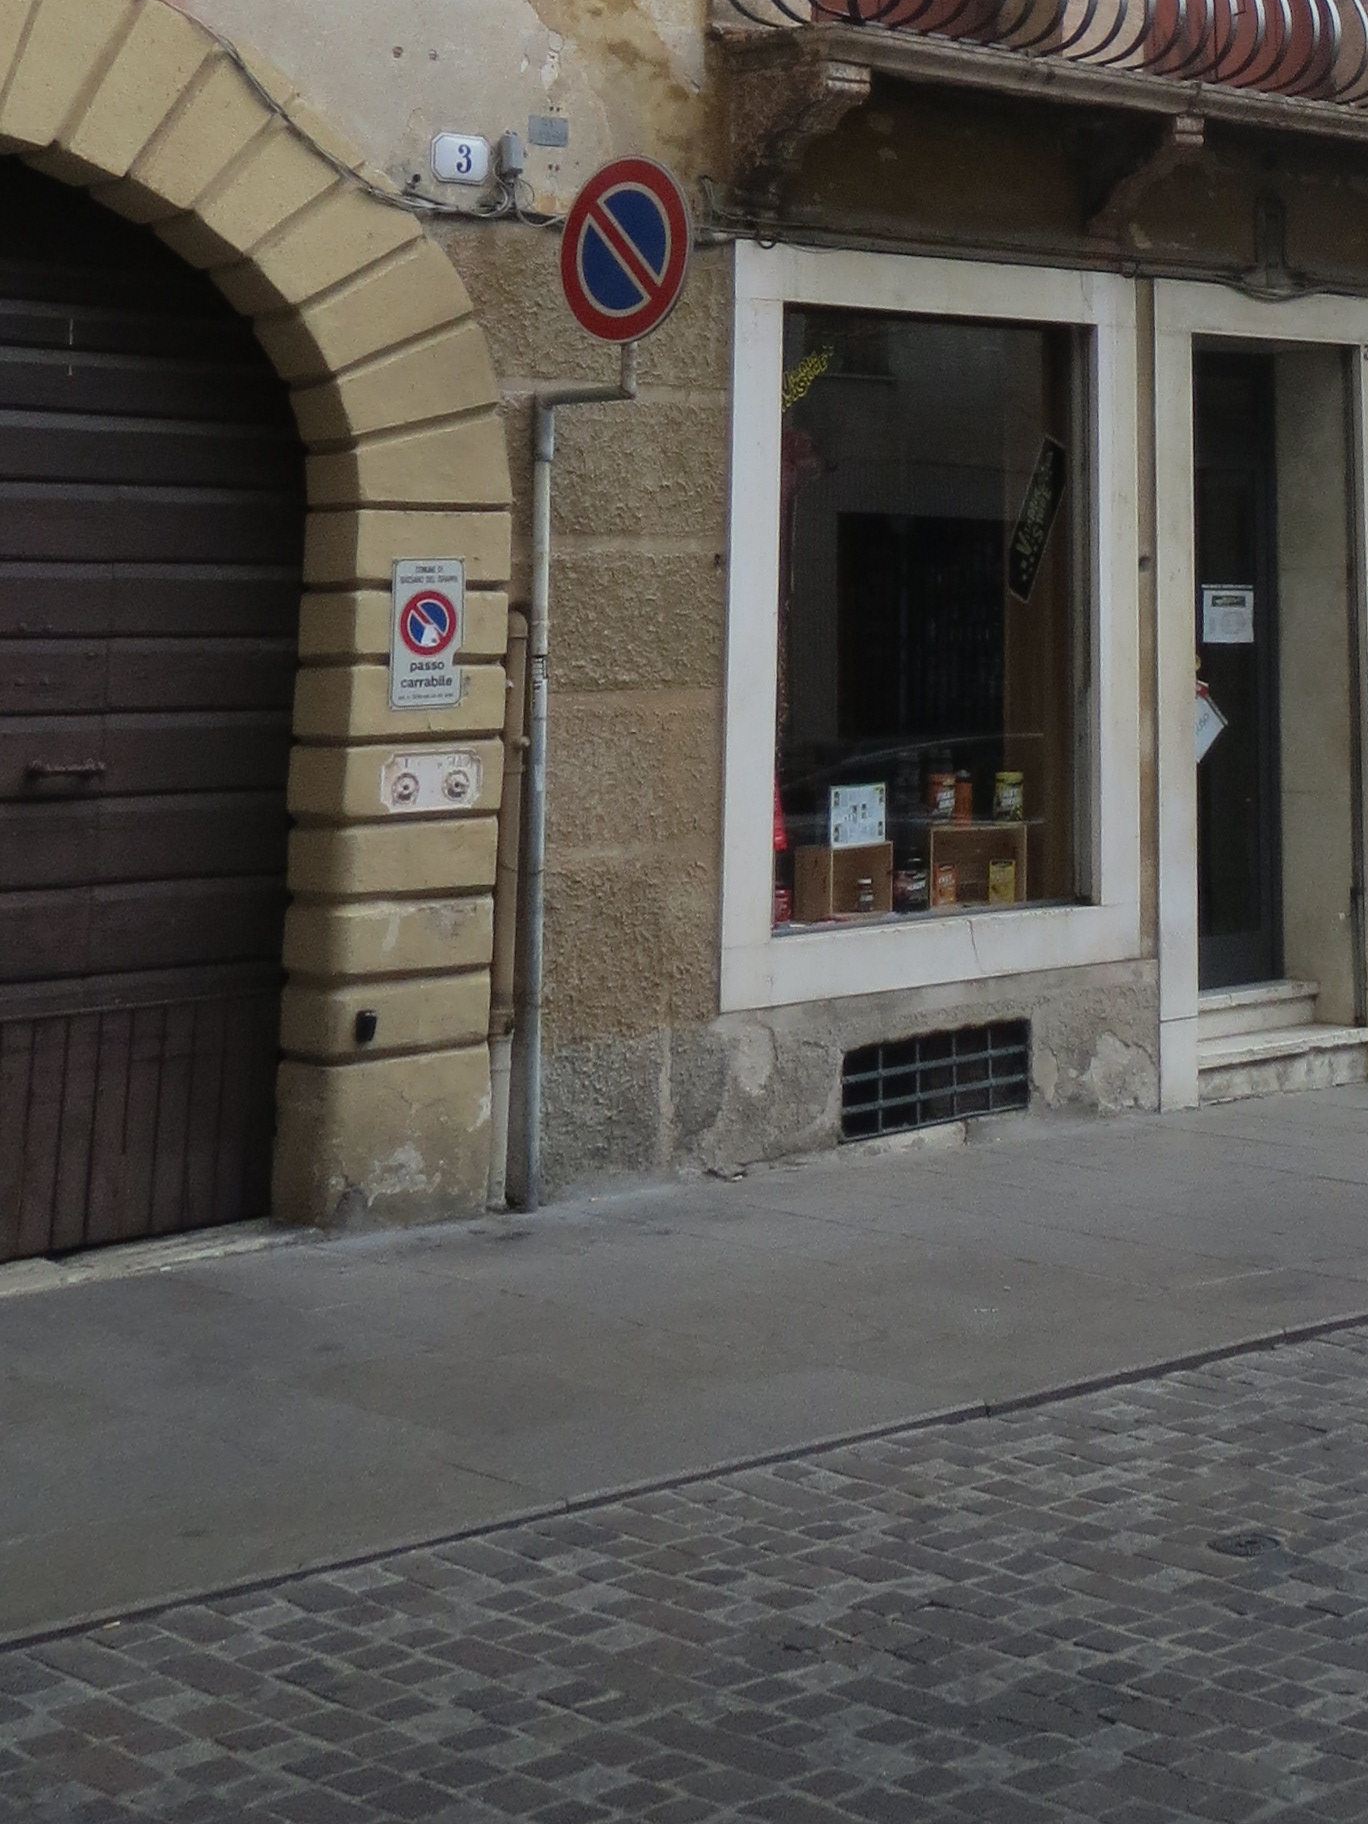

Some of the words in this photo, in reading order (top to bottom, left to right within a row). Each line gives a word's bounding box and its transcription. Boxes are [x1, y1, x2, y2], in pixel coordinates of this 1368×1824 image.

[456, 143, 472, 174] 3
[409, 660, 445, 673] passo
[400, 675, 453, 689] carrabile
